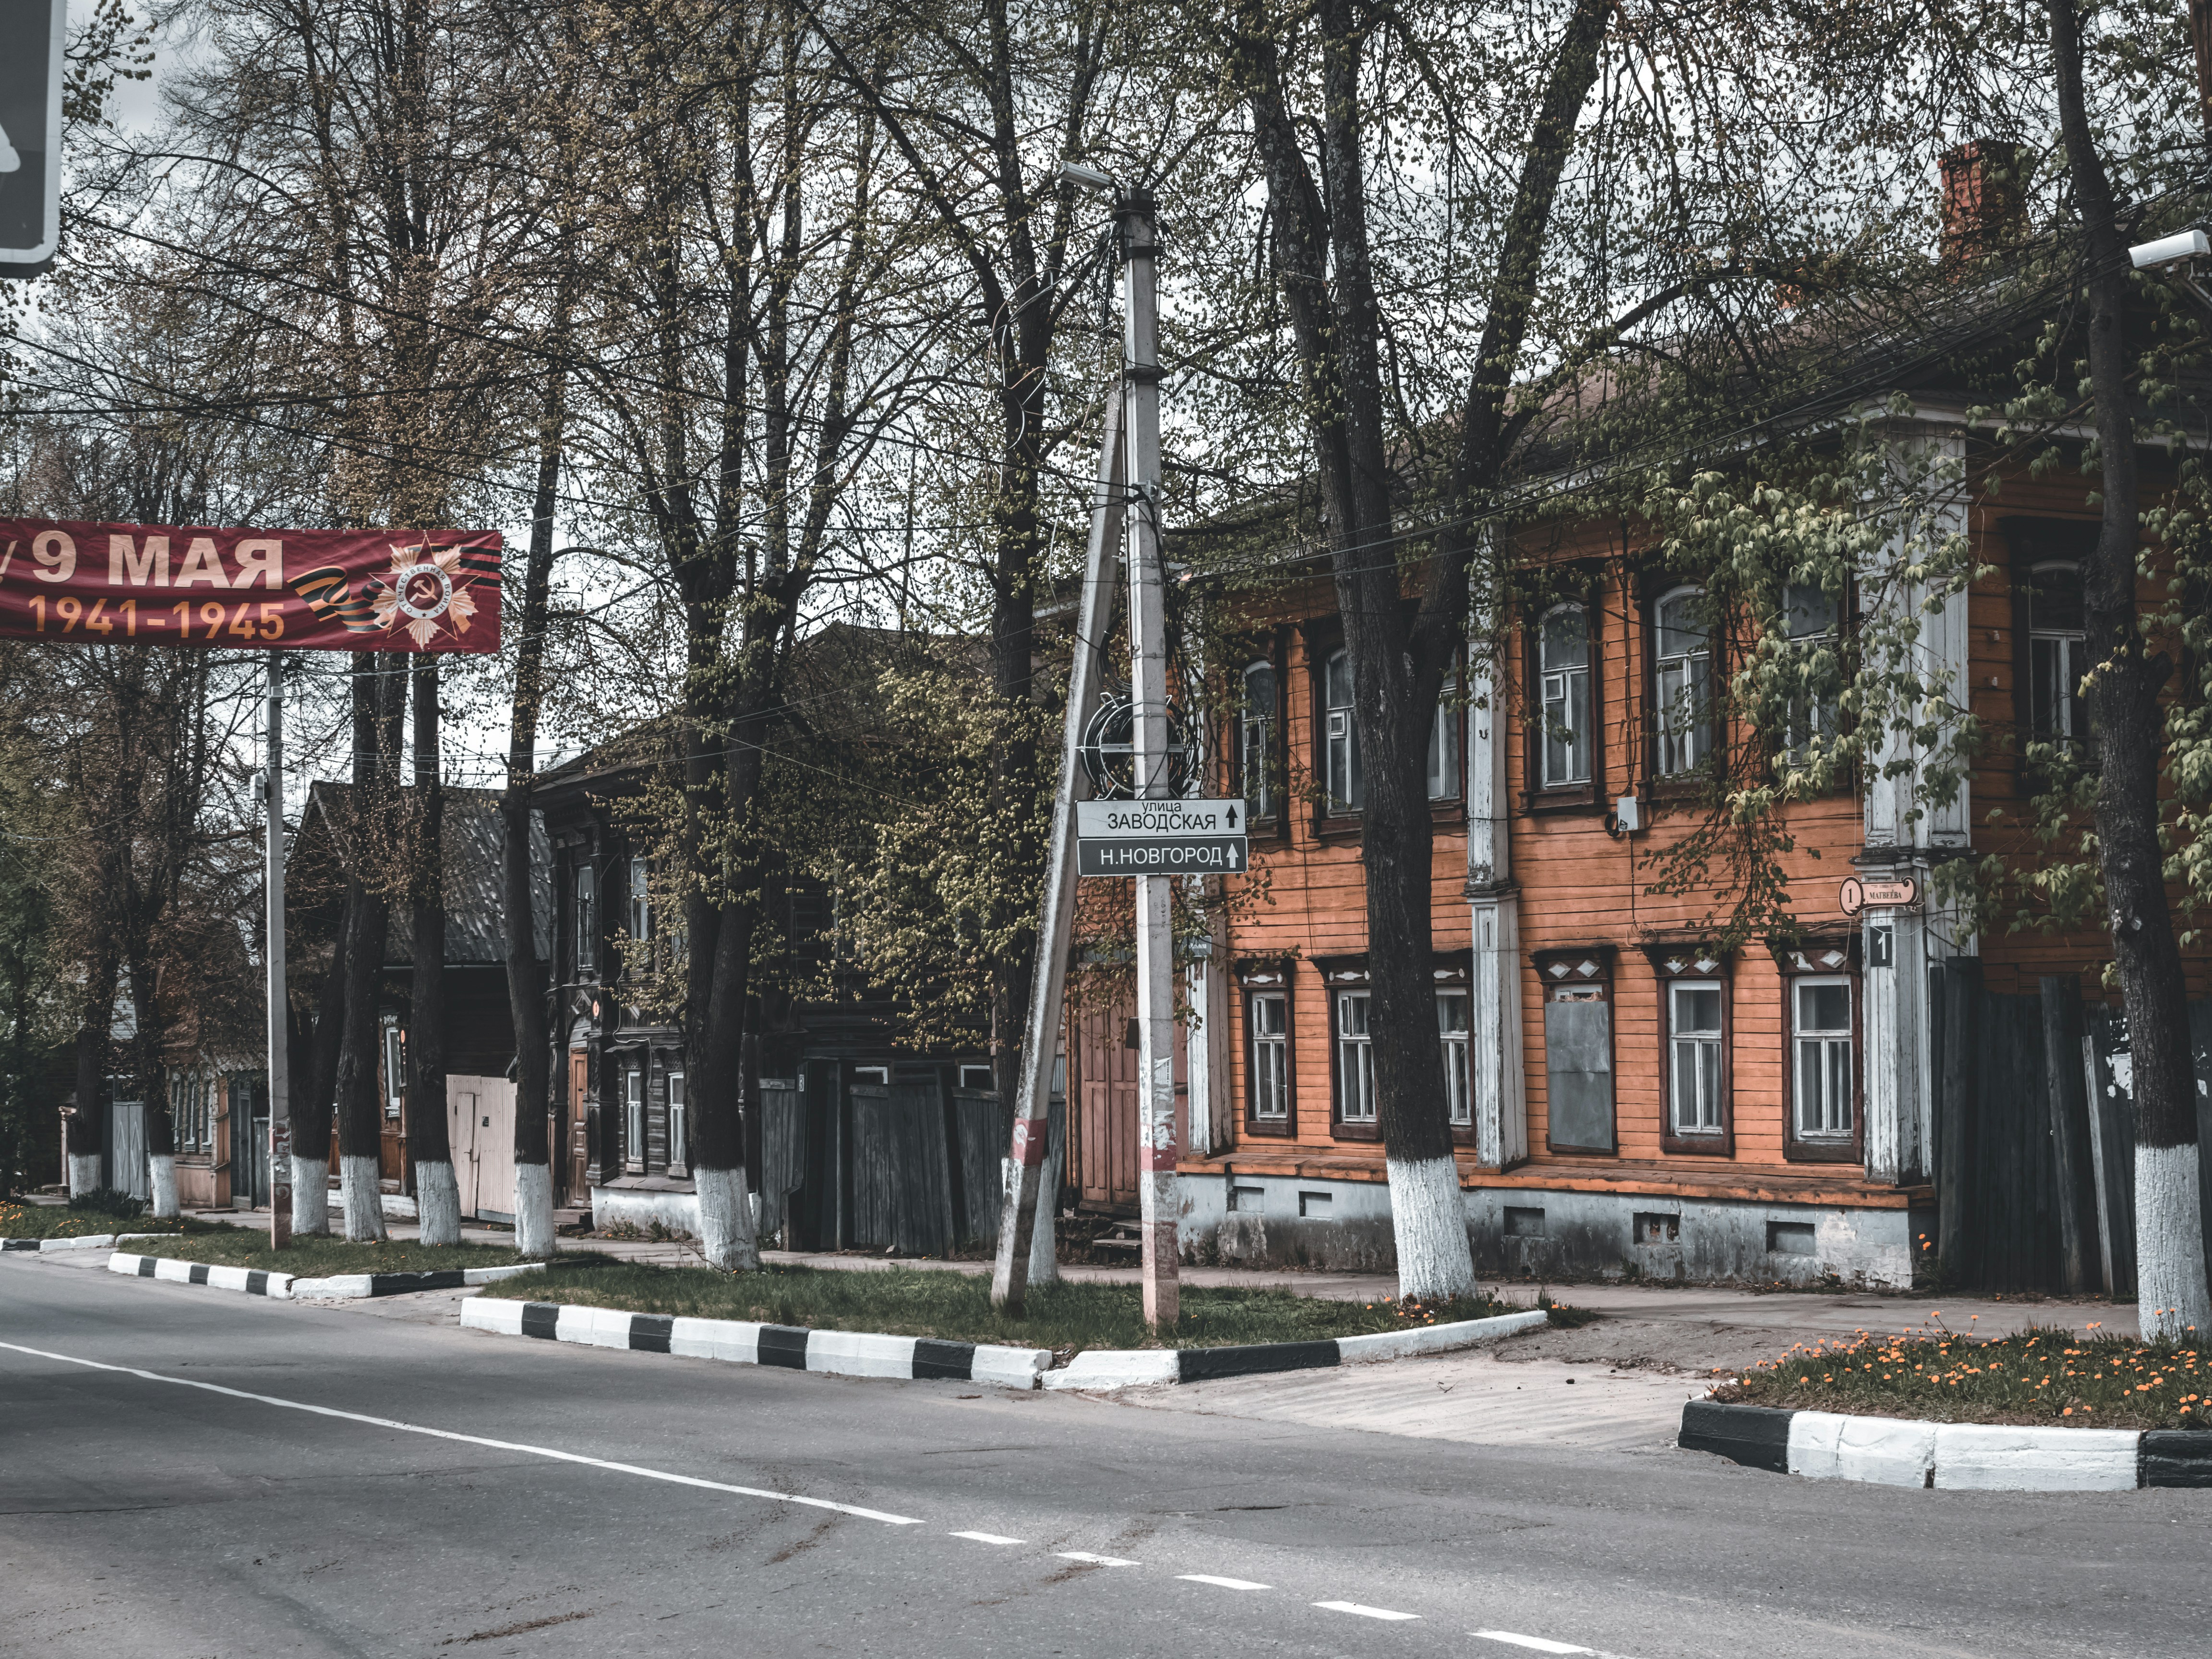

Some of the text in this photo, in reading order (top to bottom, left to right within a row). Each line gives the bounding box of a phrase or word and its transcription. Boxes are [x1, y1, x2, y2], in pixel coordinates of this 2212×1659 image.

[32, 530, 283, 590] 9 МАЯ
[397, 565, 446, 613] ОТЕЧЕСТВЕННАЯ
[29, 595, 285, 640] 1941-1945
[1142, 802, 1182, 814] улица
[1107, 813, 1216, 832] ЗАВОДСКАЯ
[1101, 847, 1223, 866] Н.НОВГОРОД
[1848, 888, 1852, 903] 1
[1878, 932, 1886, 960] 1
